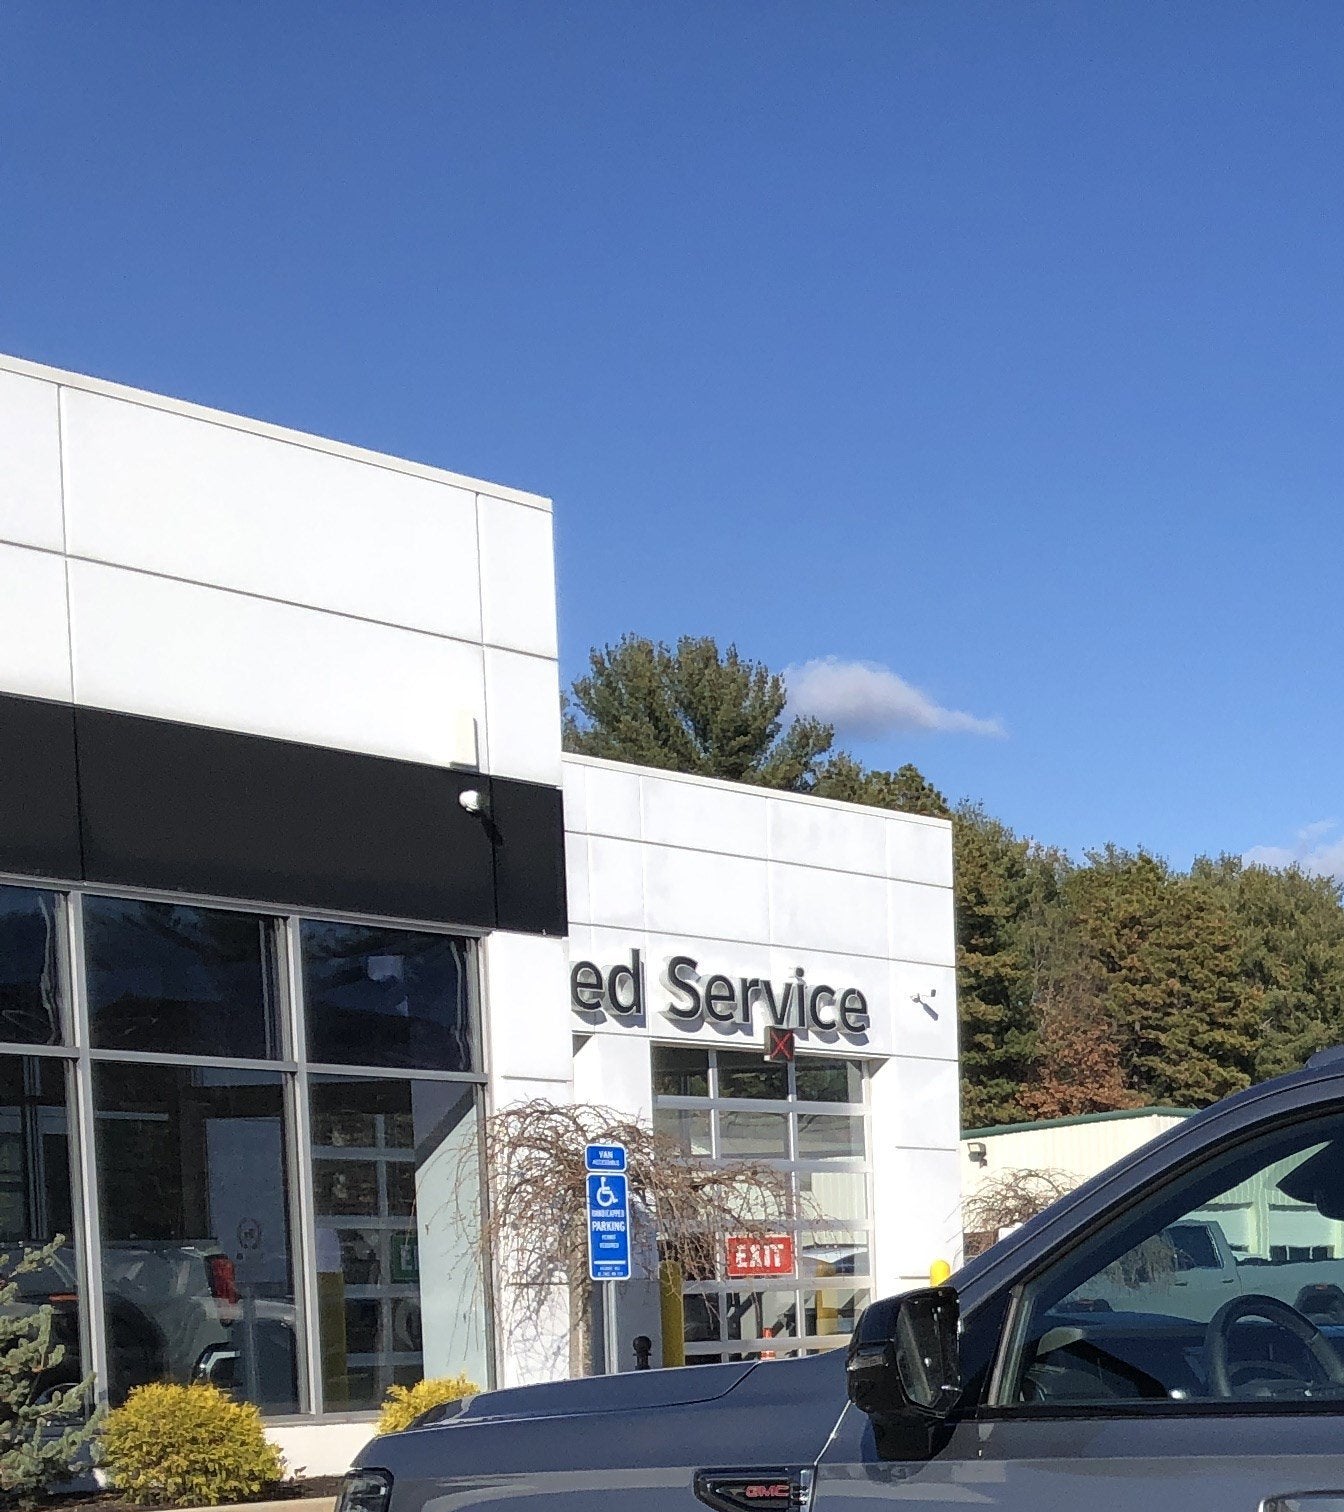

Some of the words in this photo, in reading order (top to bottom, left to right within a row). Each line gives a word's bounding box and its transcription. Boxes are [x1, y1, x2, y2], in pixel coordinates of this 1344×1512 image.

[570, 948, 645, 1016] ed
[667, 955, 869, 1034] Service
[598, 1150, 613, 1158] VAN
[591, 1221, 626, 1232] PARKING
[735, 1243, 784, 1268] EXIT
[745, 1485, 790, 1498] GMC
